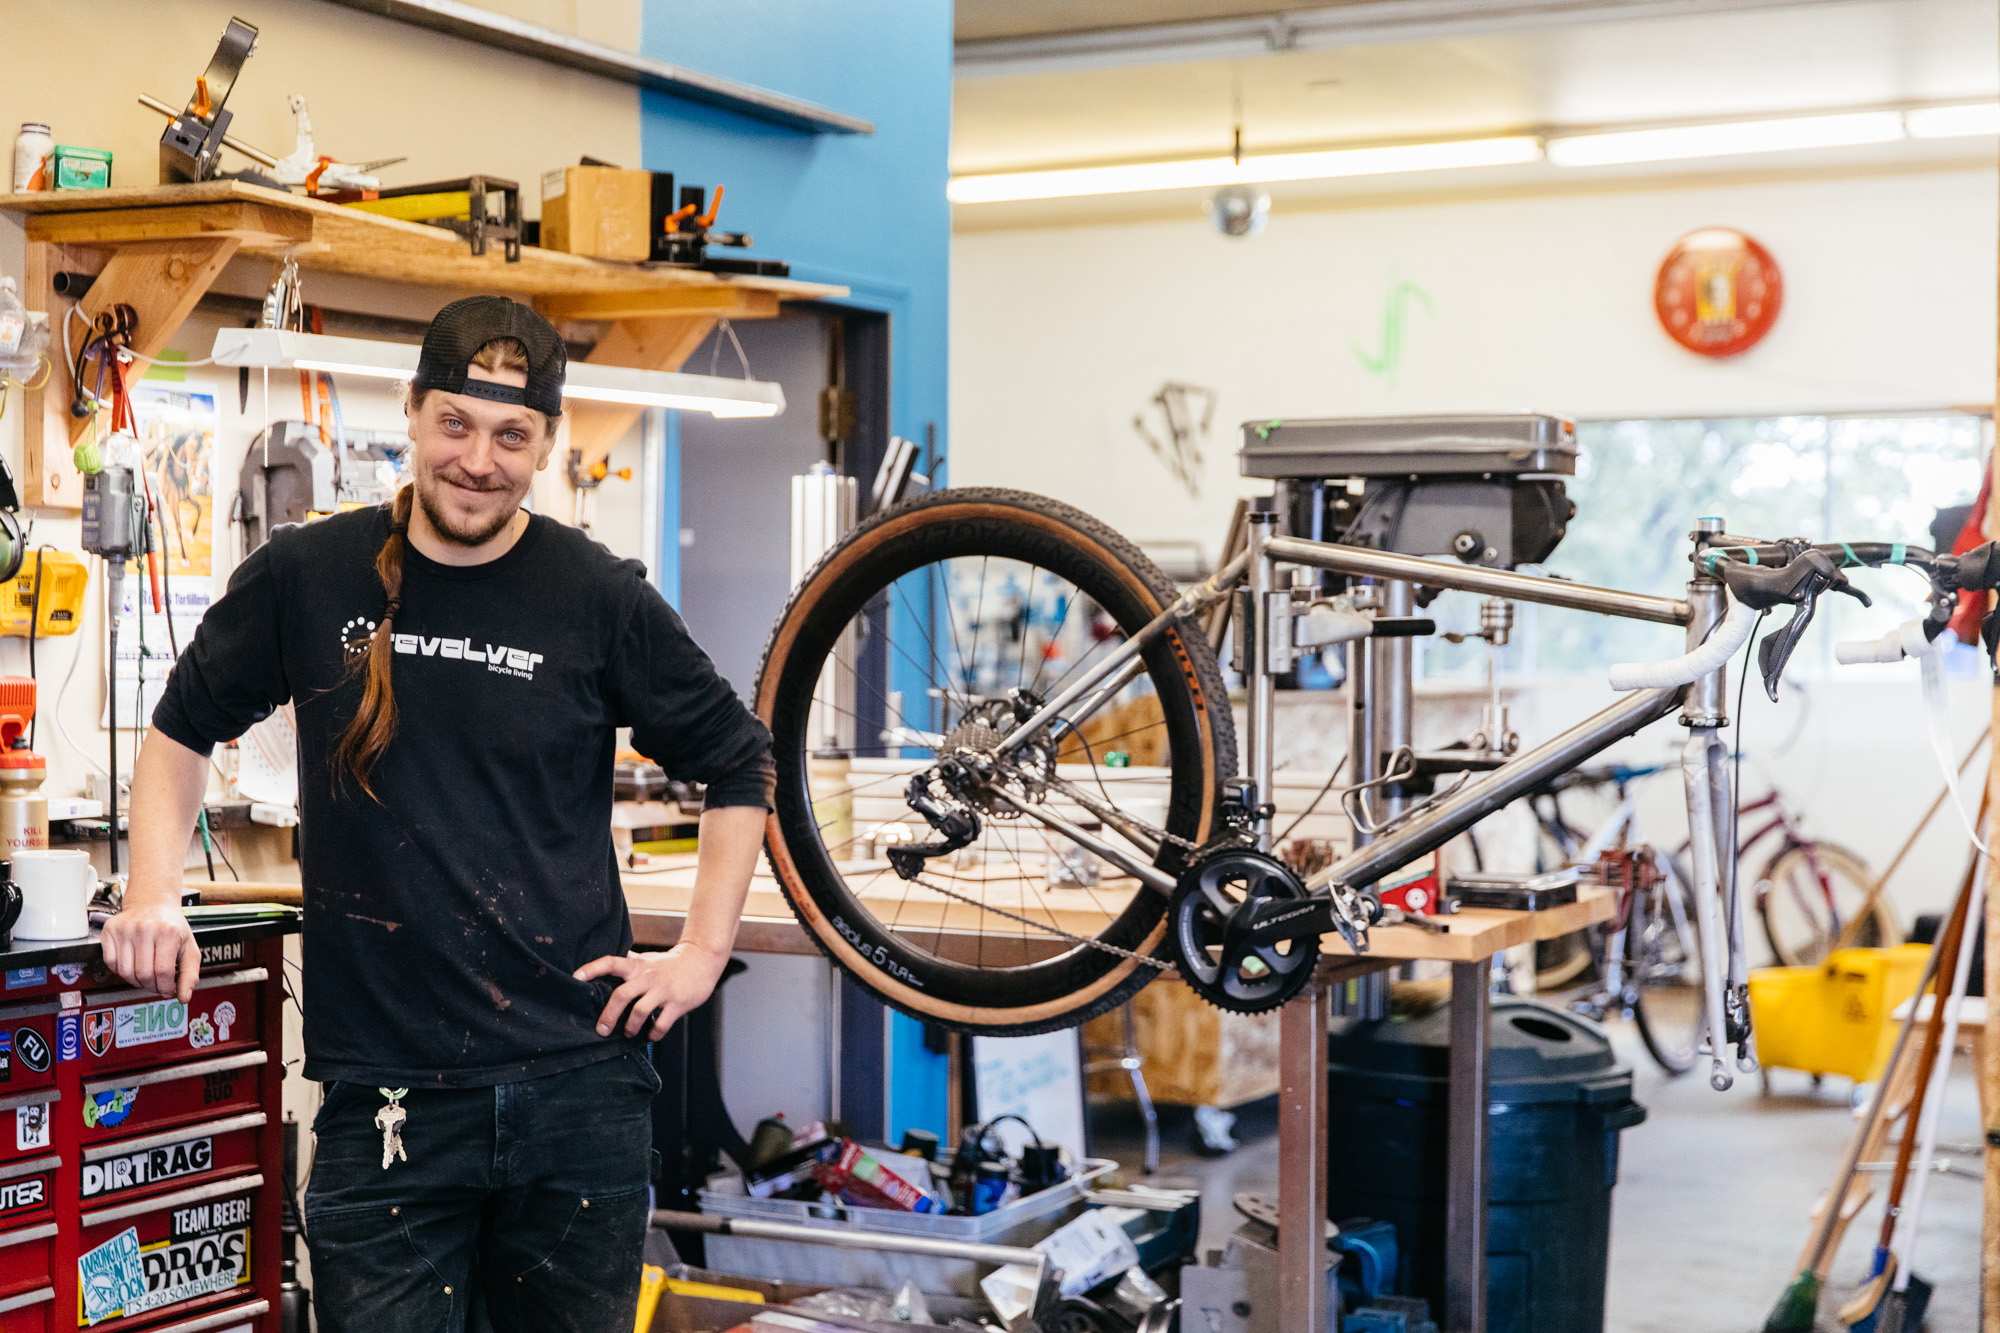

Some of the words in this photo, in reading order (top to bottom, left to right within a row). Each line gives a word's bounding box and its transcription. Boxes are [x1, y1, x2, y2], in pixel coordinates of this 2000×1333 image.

[488, 663, 512, 676] bicycle
[513, 668, 533, 681] living
[23, 826, 43, 836] KILL
[872, 945, 889, 966] 5
[22, 1034, 45, 1061] FU
[118, 1037, 141, 1045] WHITE
[173, 1205, 210, 1236] TEAM
[213, 1197, 251, 1228] BEER!
[123, 1251, 142, 1278] THE
[123, 1299, 142, 1316] IT'S
[144, 1292, 167, 1307] 4:20
[169, 1270, 237, 1302] SOMEWHERE
